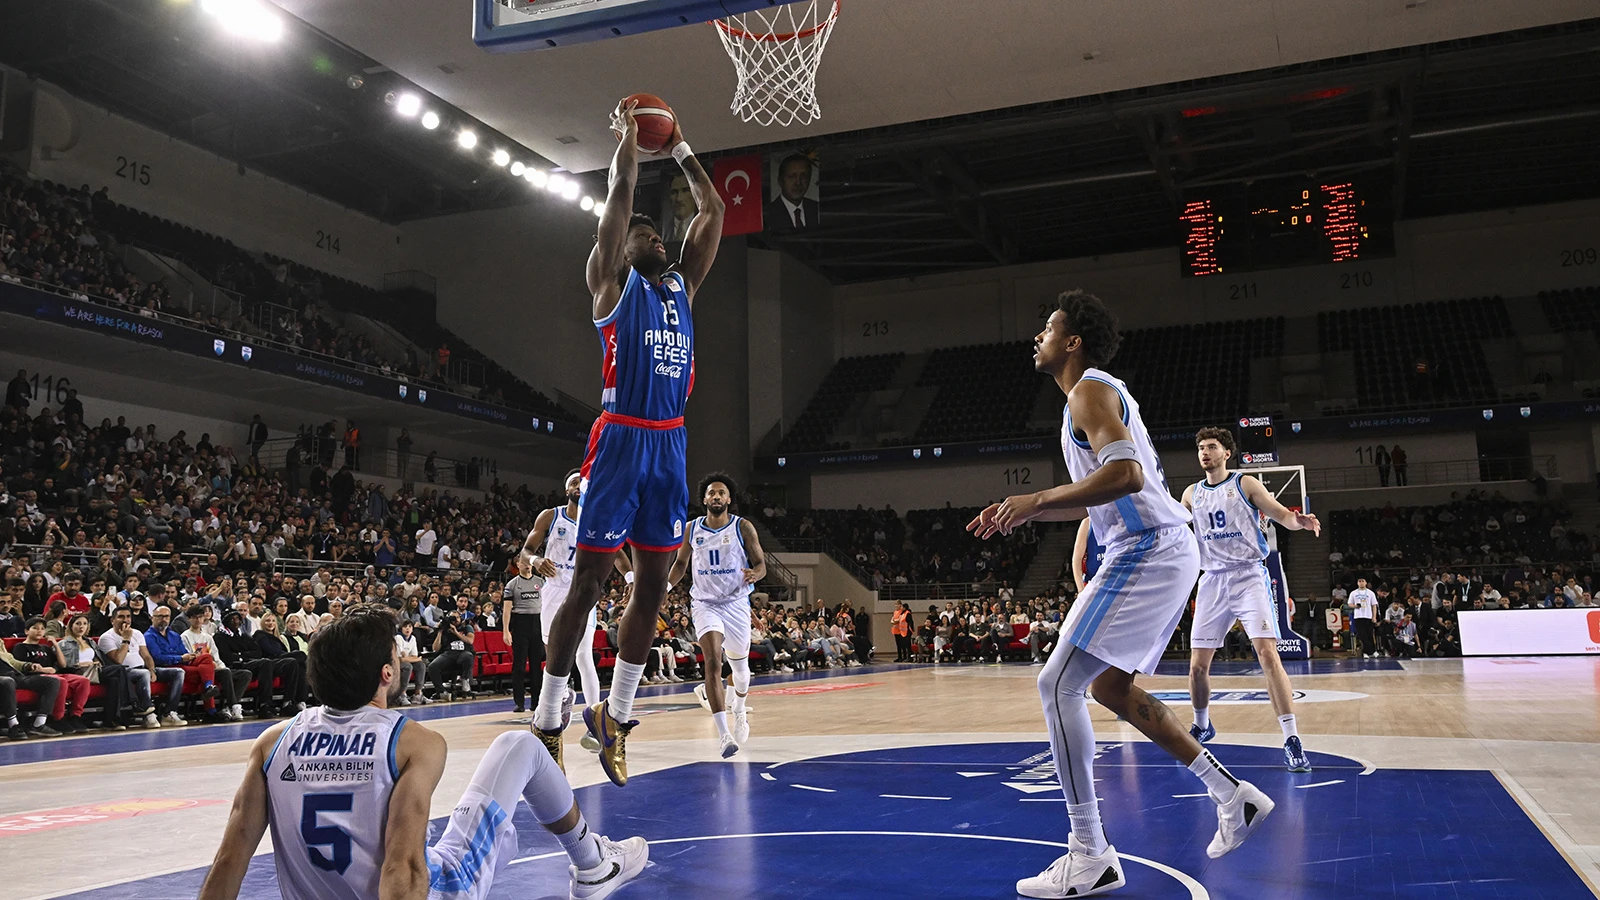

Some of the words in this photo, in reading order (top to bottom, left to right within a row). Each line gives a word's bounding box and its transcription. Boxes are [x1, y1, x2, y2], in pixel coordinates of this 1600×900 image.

[116, 156, 150, 185] 215
[1302, 190, 1309, 200] 0
[1291, 215, 1298, 225] 0
[316, 230, 340, 254] 214
[1560, 248, 1597, 267] 209
[1340, 271, 1373, 289] 210
[1230, 282, 1257, 300] 211
[64, 306, 76, 317] WE
[77, 309, 95, 322] ARE
[95, 313, 116, 327] HERE
[116, 318, 130, 332] FOR
[131, 322, 137, 334] A
[138, 324, 164, 339] REASON
[862, 321, 888, 337] 213
[654, 344, 688, 364] EFES
[30, 373, 70, 405] 116
[1265, 427, 1273, 437] 0
[1003, 467, 1032, 485] 112
[1208, 510, 1226, 530] 19
[1213, 531, 1243, 540] Telekom
[568, 547, 576, 561] 7
[709, 549, 720, 566] 11
[288, 732, 377, 756] AKPINAR
[298, 763, 343, 771] ANKARA
[300, 792, 354, 876] 5
